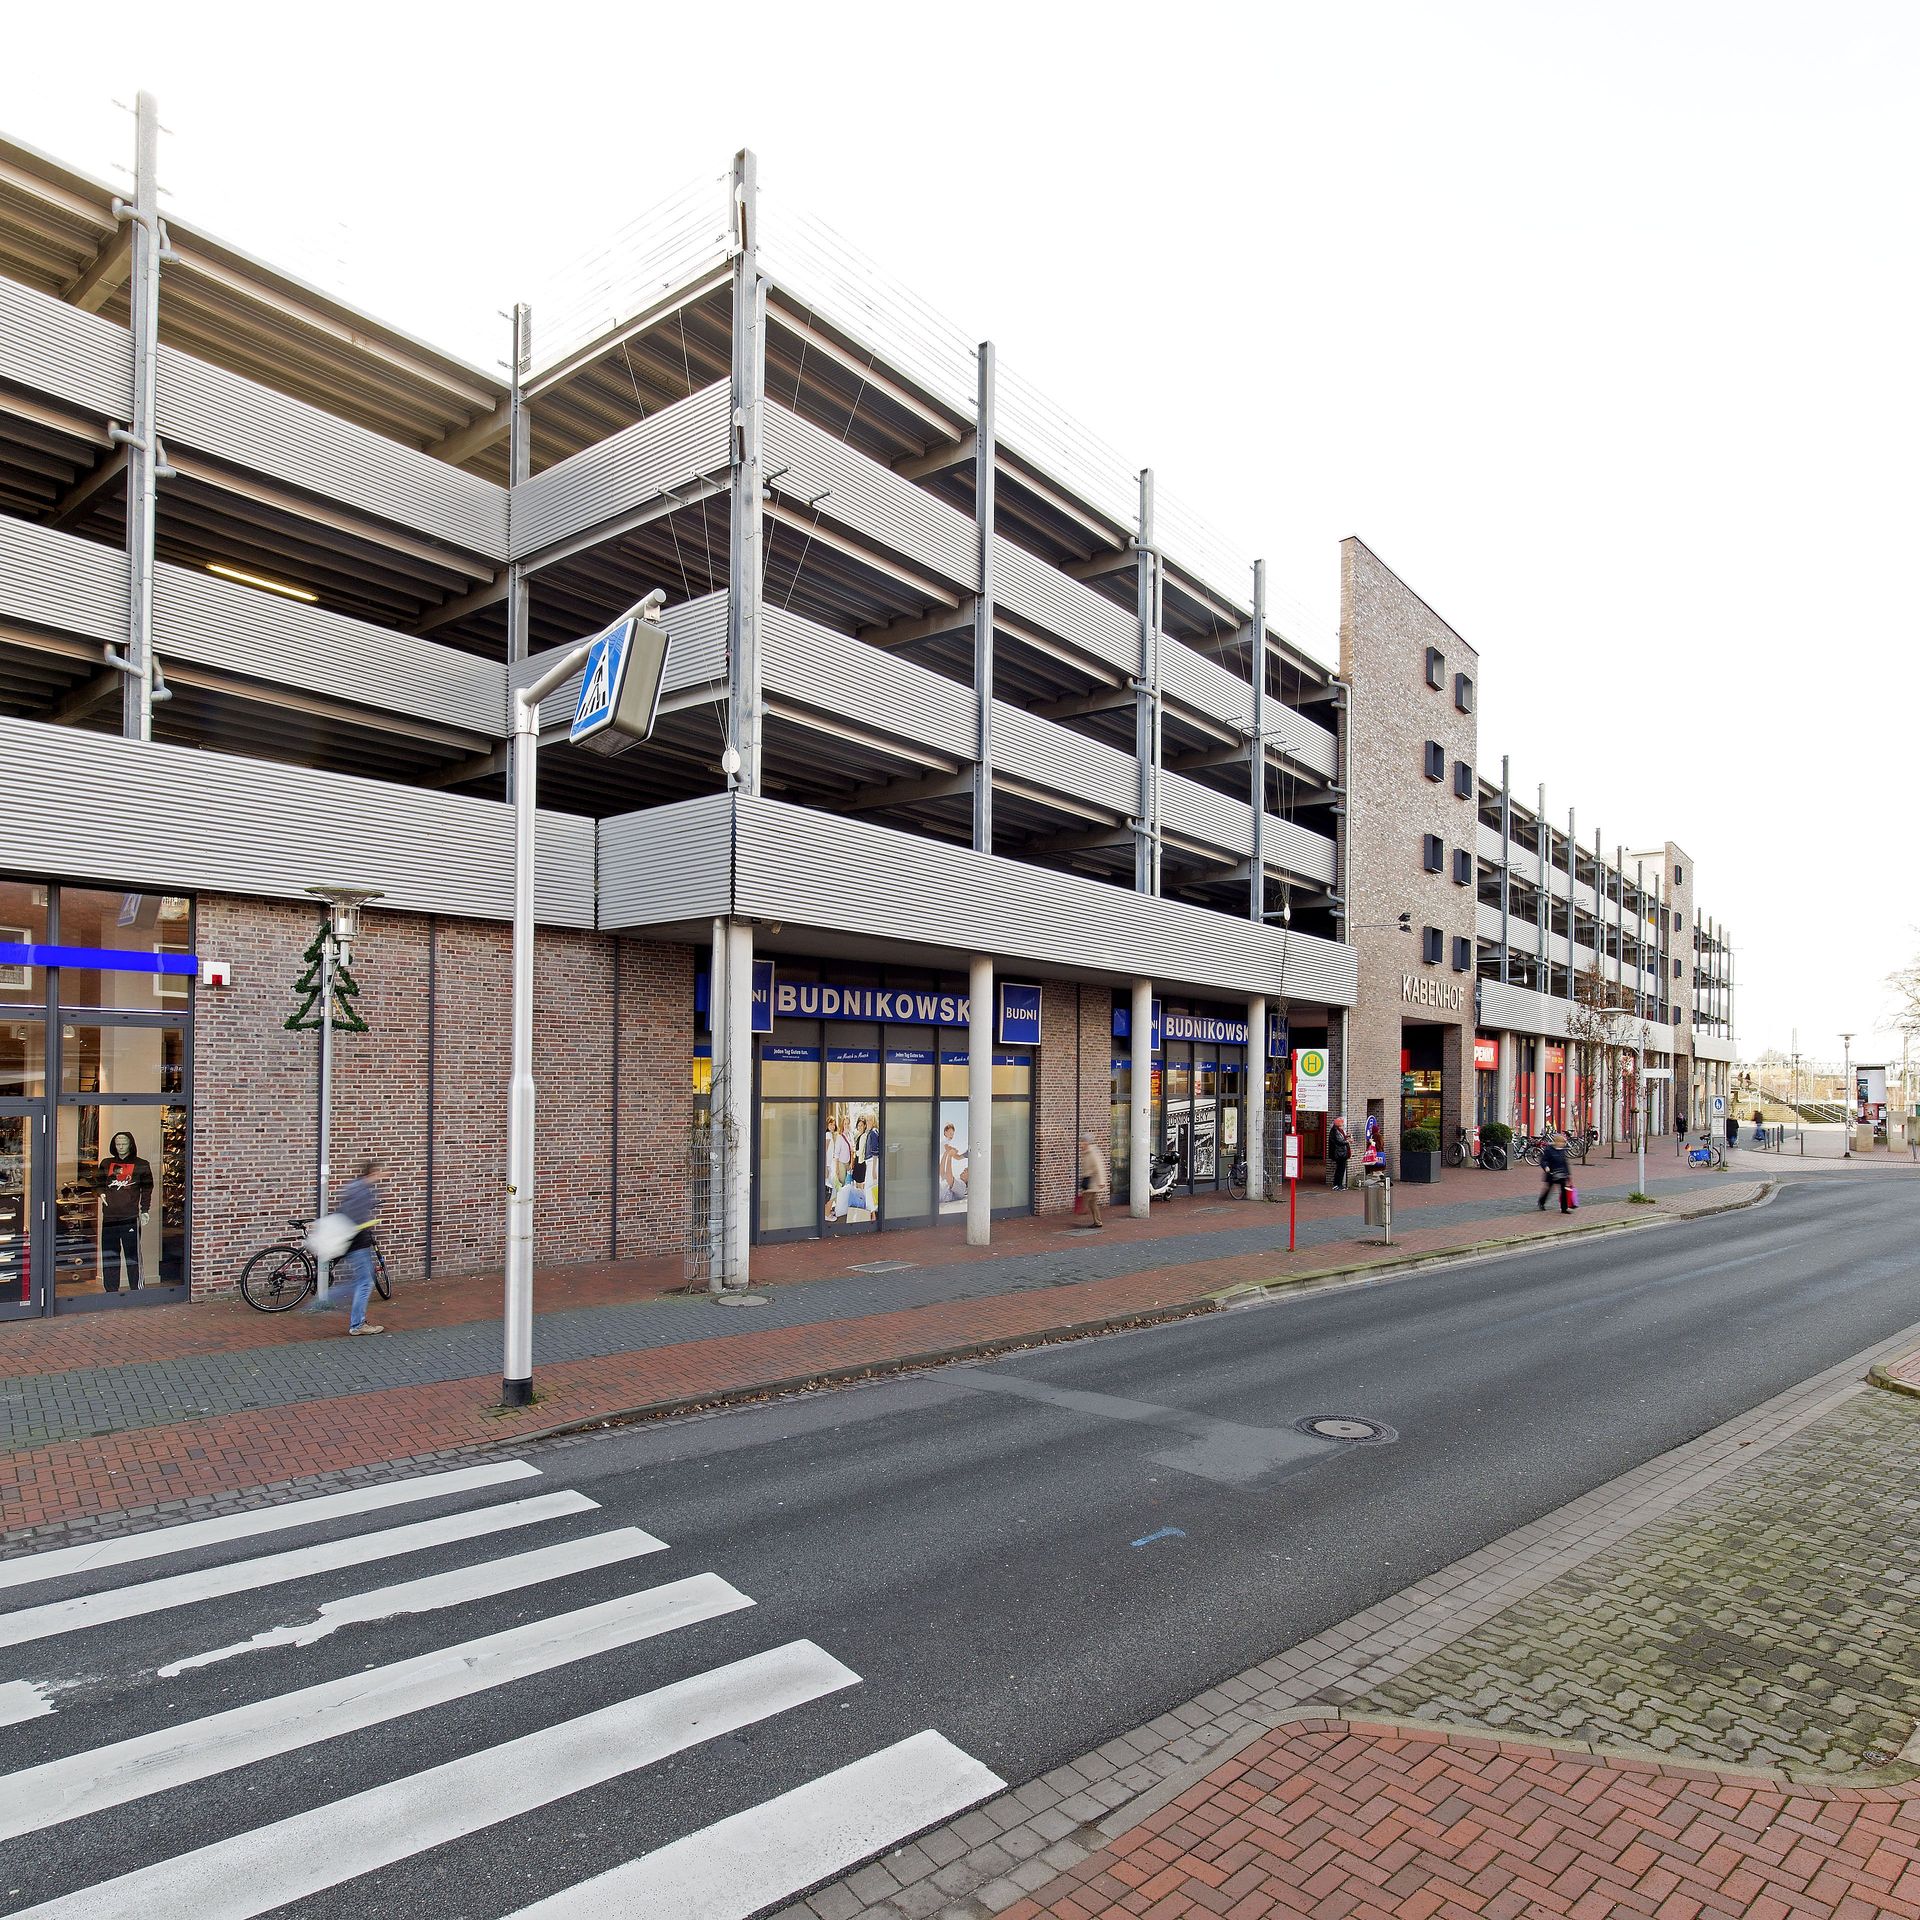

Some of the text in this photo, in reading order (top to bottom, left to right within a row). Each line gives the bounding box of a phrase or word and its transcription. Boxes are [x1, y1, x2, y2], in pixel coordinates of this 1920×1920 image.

[778, 984, 970, 1022] BUDNIKOWSK
[1401, 974, 1465, 1011] KABENHOF
[1006, 1006, 1037, 1021] BUDNI
[1166, 1017, 1248, 1042] BUDNIKOWSK
[1307, 1056, 1317, 1071] H
